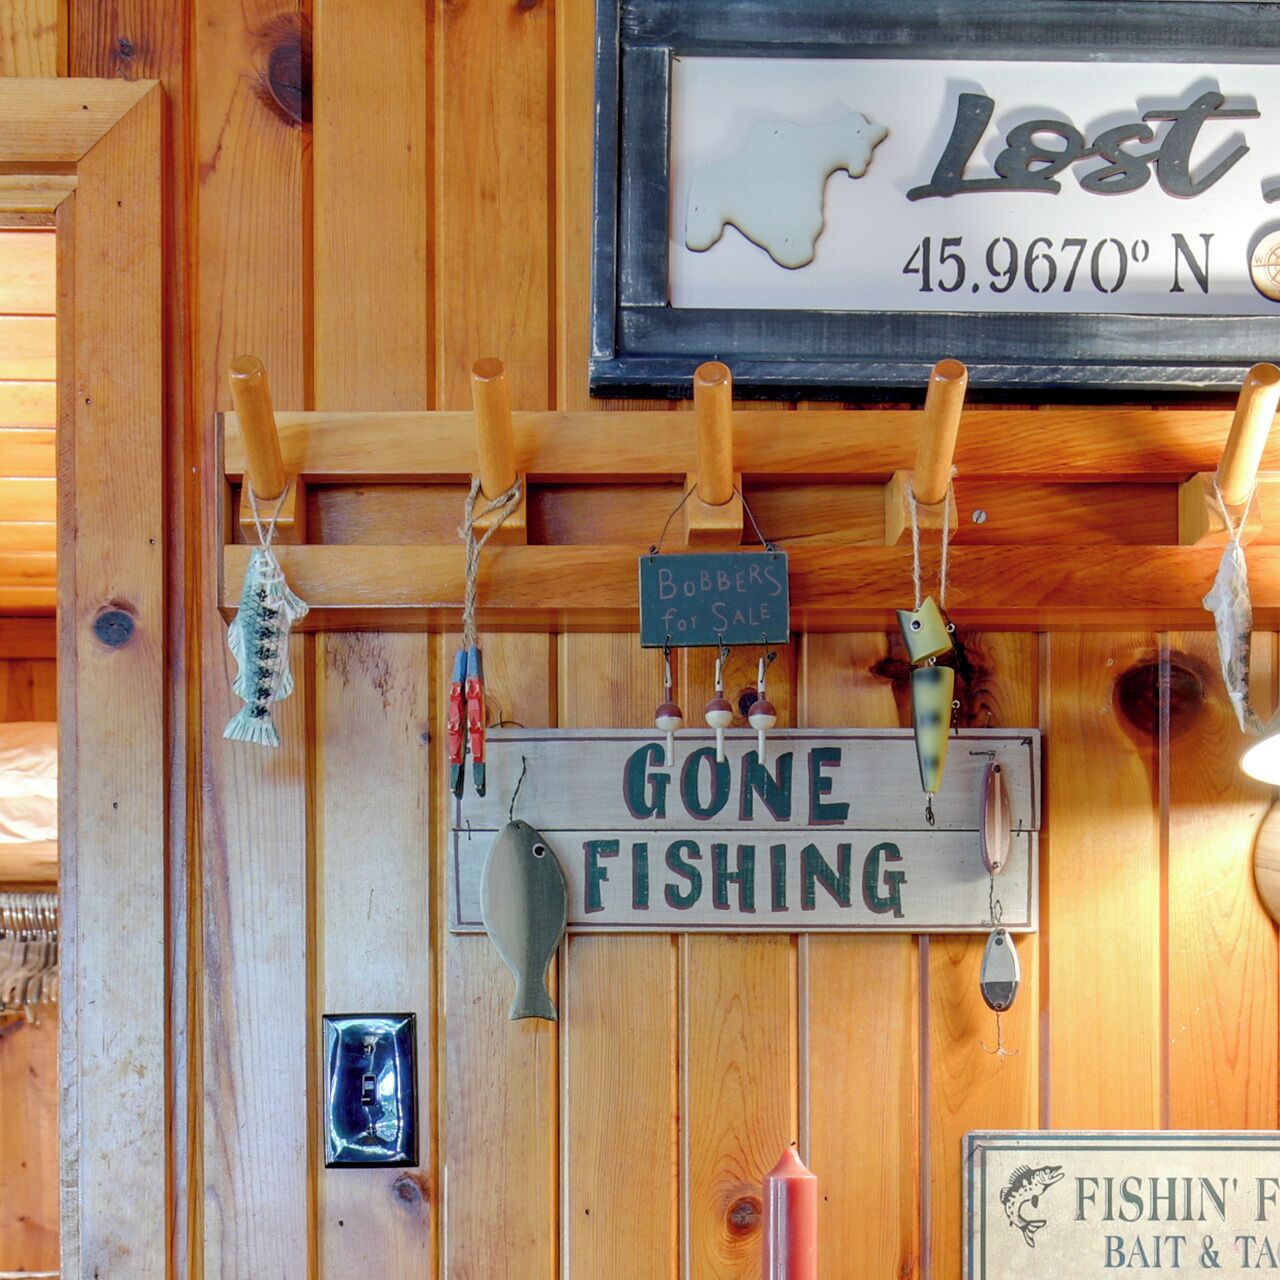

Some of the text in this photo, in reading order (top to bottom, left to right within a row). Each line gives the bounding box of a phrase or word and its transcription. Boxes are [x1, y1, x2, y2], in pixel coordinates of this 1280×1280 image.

[907, 91, 1261, 201] Lost
[1169, 232, 1215, 294] N
[661, 602, 770, 632] for SALE
[622, 740, 851, 827] GONE
[582, 839, 908, 918] FISHING
[1074, 1176, 1238, 1222] FISHIN'
[1104, 1235, 1187, 1268] BAIT
[1199, 1234, 1222, 1269] &
